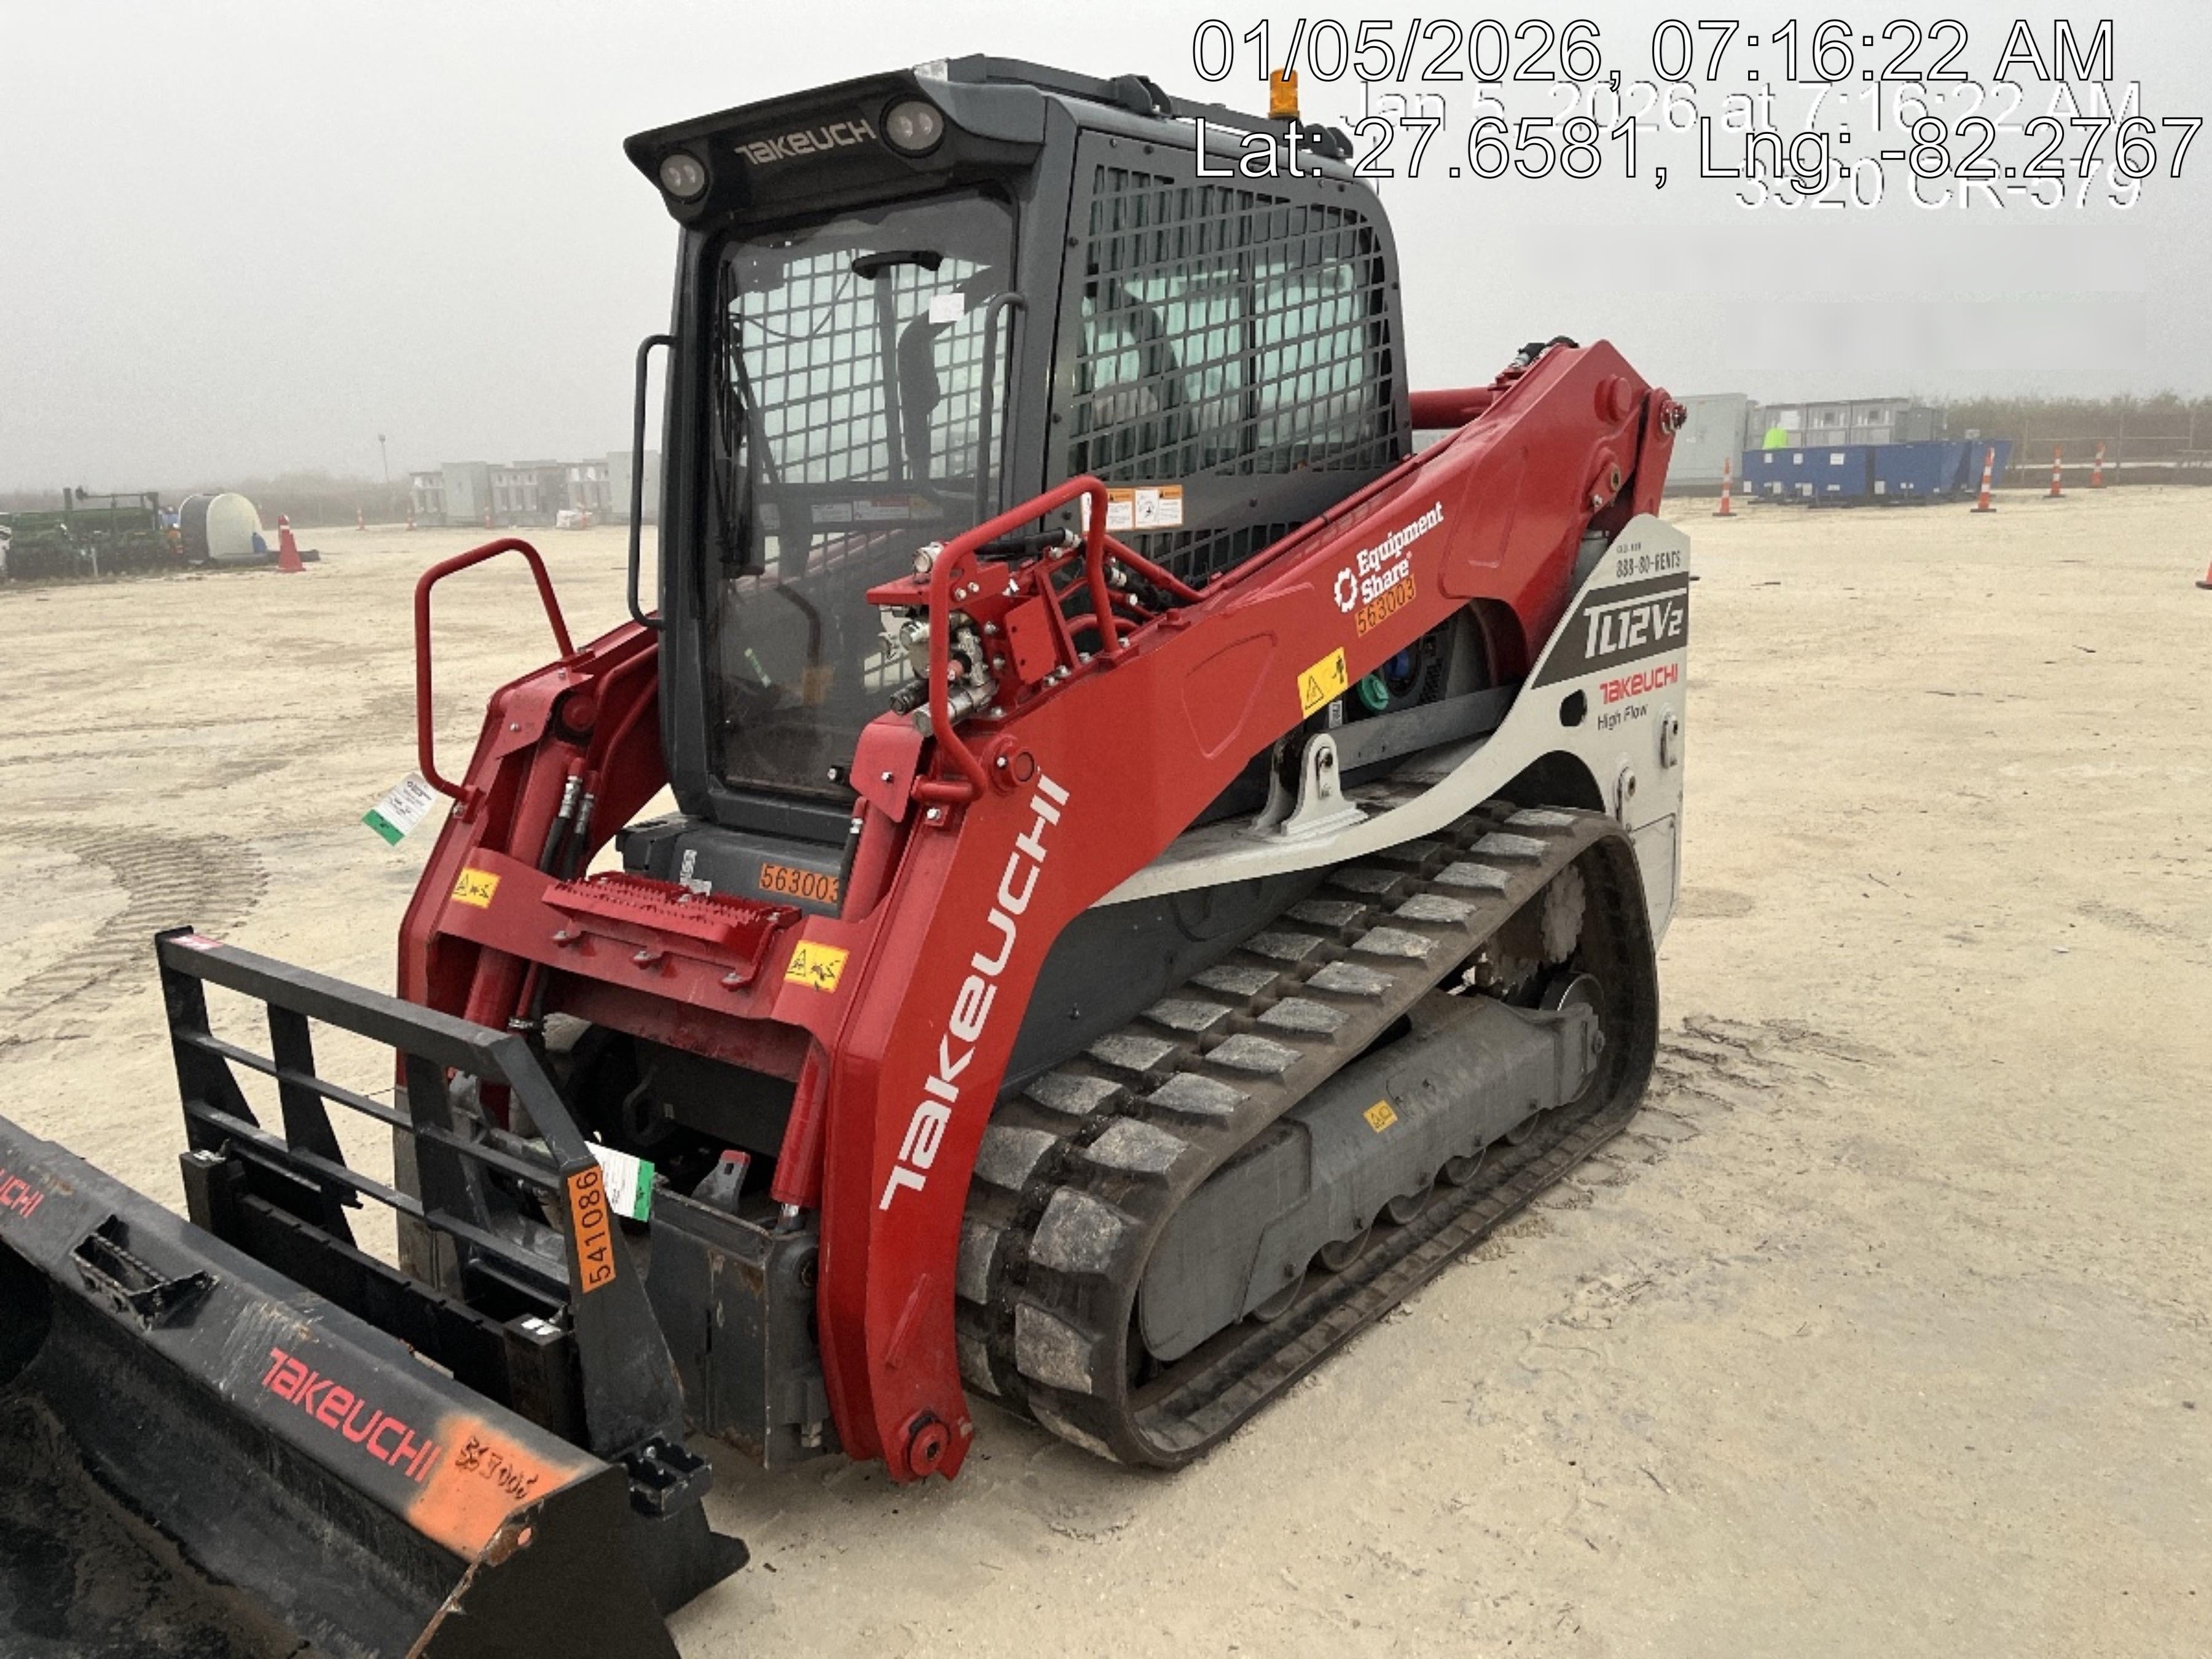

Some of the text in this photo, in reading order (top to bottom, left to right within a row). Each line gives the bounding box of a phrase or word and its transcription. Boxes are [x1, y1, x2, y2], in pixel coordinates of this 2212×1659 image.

[1356, 501, 1444, 577] Equipment
[1357, 576, 1415, 635] 563003
[1361, 558, 1410, 605] Share
[1597, 704, 1648, 731] High Flow
[576, 1171, 611, 1284] 541086
